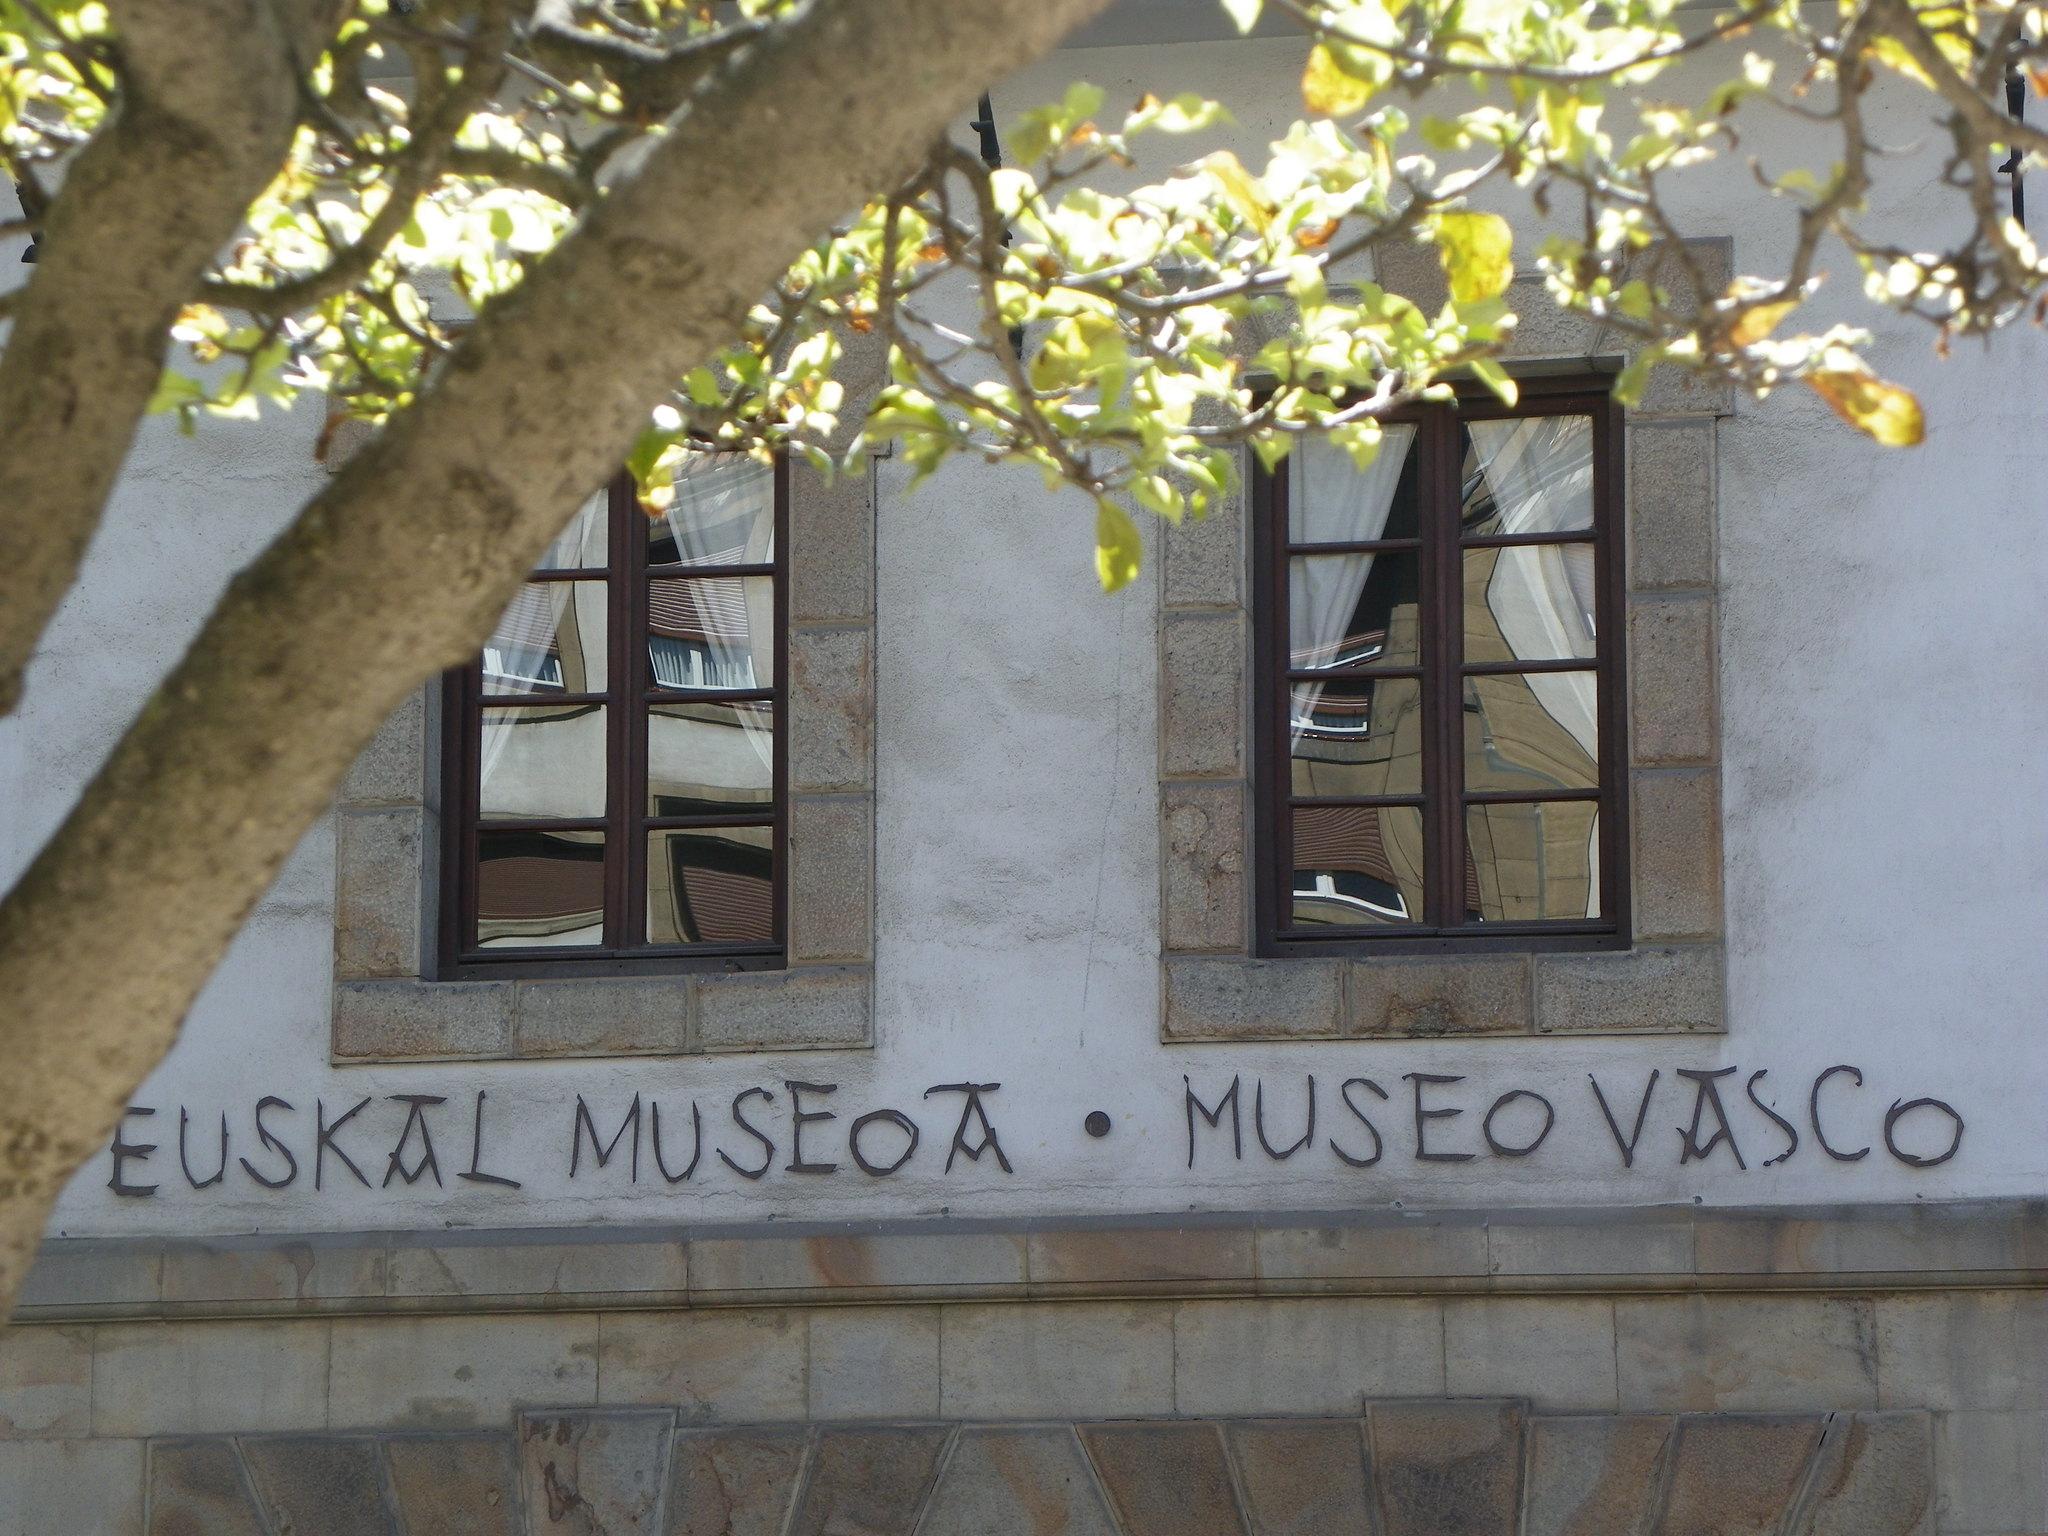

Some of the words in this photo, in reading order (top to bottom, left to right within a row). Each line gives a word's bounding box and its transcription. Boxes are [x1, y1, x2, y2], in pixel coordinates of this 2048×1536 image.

[107, 1089, 522, 1196] EUSKAL
[569, 1080, 1013, 1184] MUSEOA
[1183, 1072, 1555, 1170] MUSEO
[1587, 1064, 1965, 1171] VASCO
